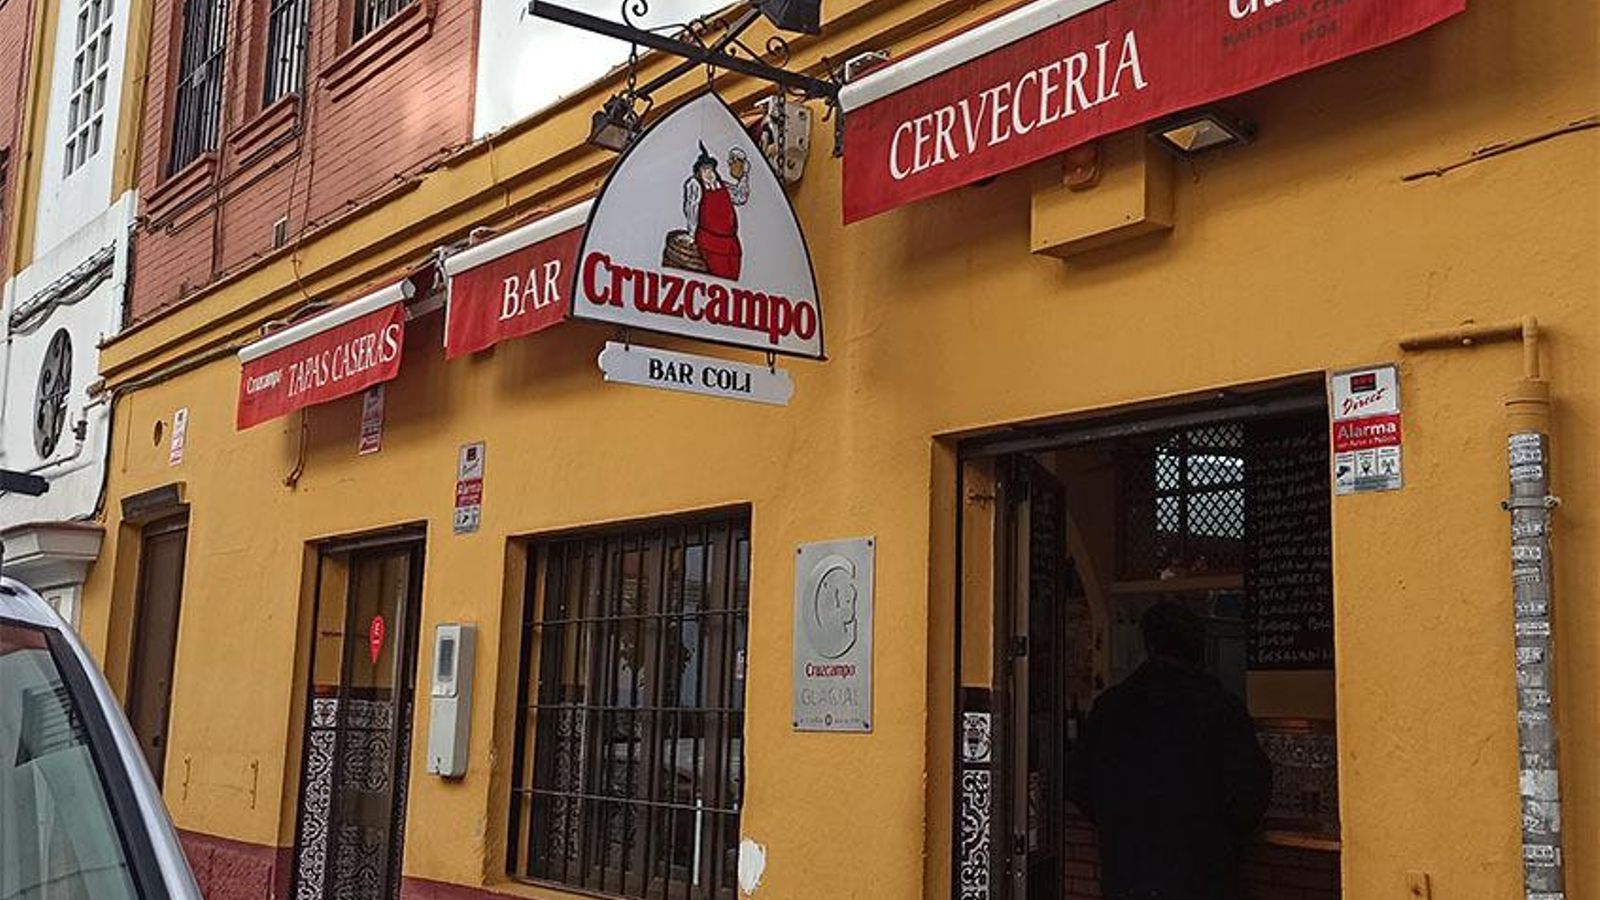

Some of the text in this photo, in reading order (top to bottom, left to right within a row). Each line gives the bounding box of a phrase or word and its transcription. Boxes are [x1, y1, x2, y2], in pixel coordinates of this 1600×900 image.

[889, 29, 1148, 182] CERVECERIA
[500, 259, 562, 321] BAR
[582, 252, 816, 344] Cruzcampo
[287, 323, 400, 398] TAPAS CASERAS
[649, 357, 753, 394] BAR COLI
[1338, 421, 1397, 440] Alarma
[805, 662, 856, 679] Cruzcampo
